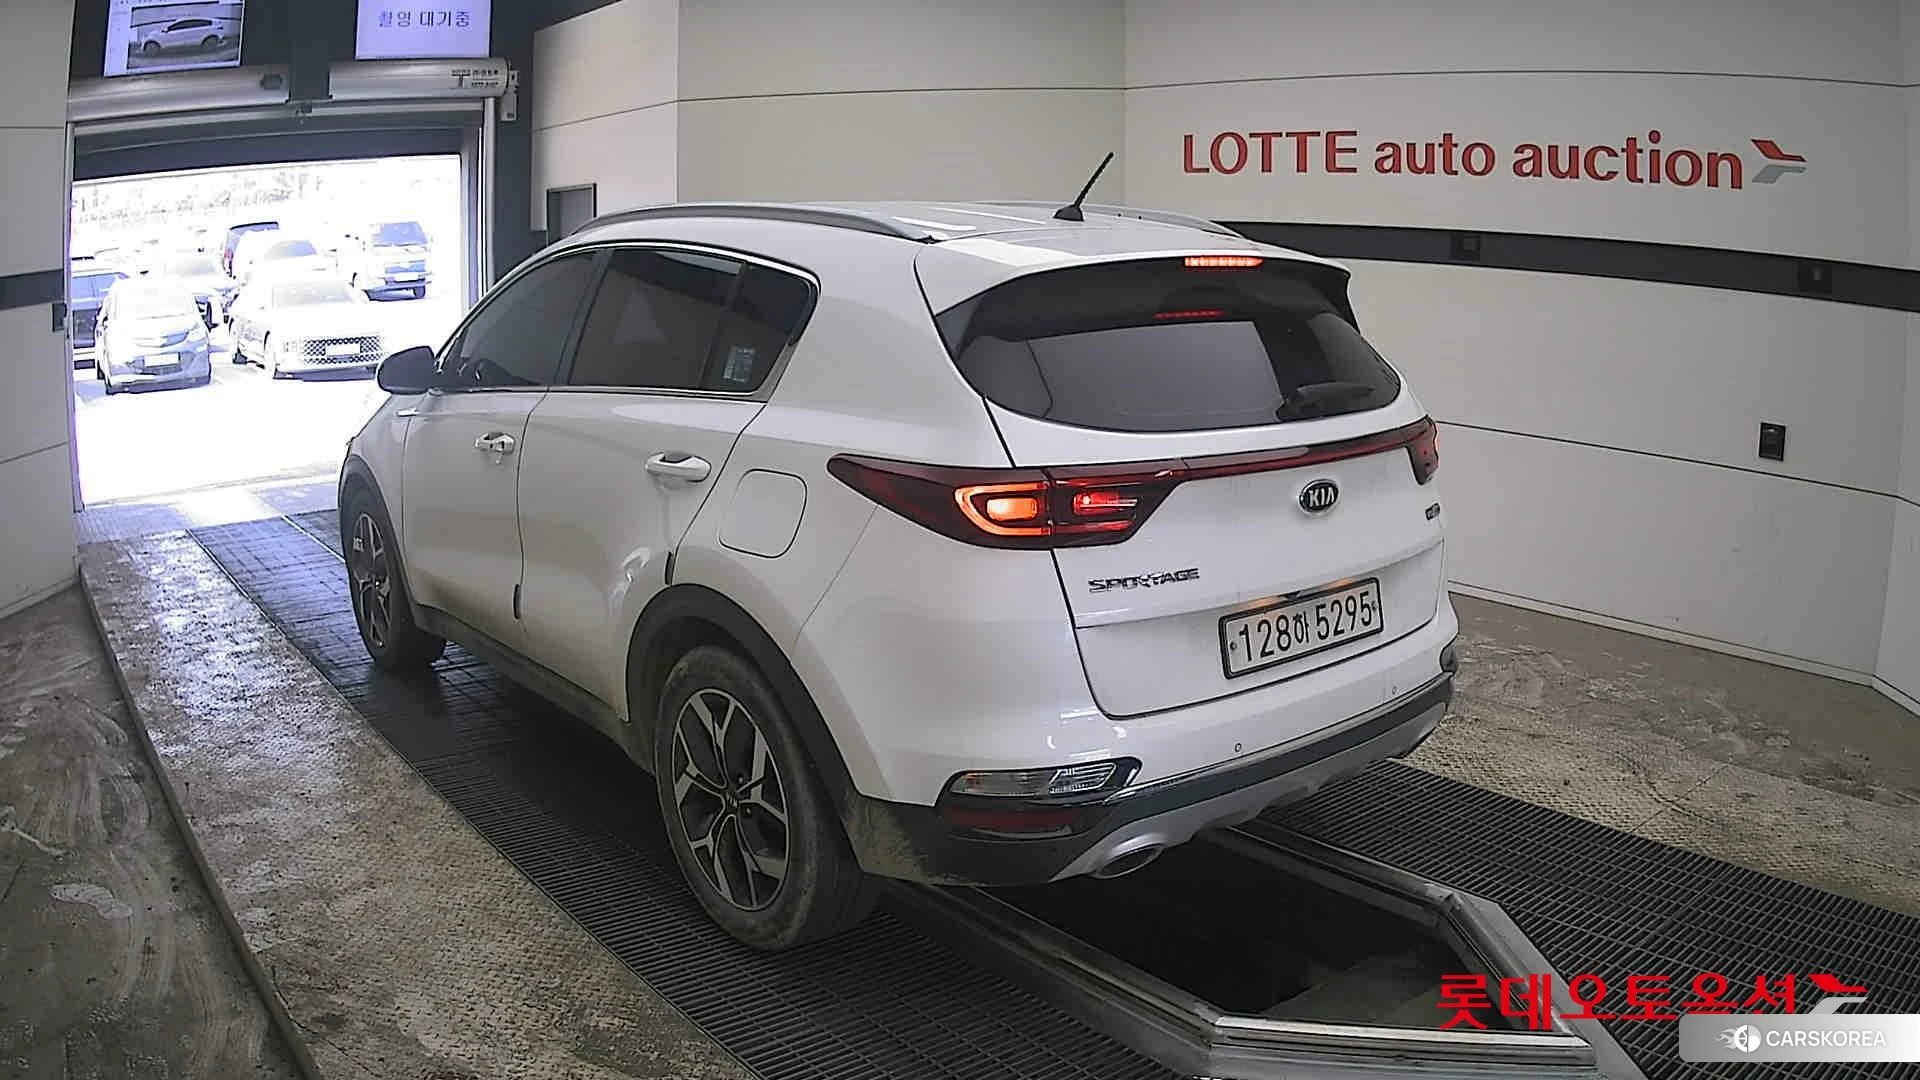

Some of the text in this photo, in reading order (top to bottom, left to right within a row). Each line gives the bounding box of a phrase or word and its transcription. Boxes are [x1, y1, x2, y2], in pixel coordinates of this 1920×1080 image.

[420, 11, 470, 27] 대기중
[1184, 131, 1742, 189] LOTTE auto auction
[1309, 487, 1334, 507] KIA
[1088, 568, 1200, 593] SPORTAGE
[1315, 590, 1372, 640] 5295
